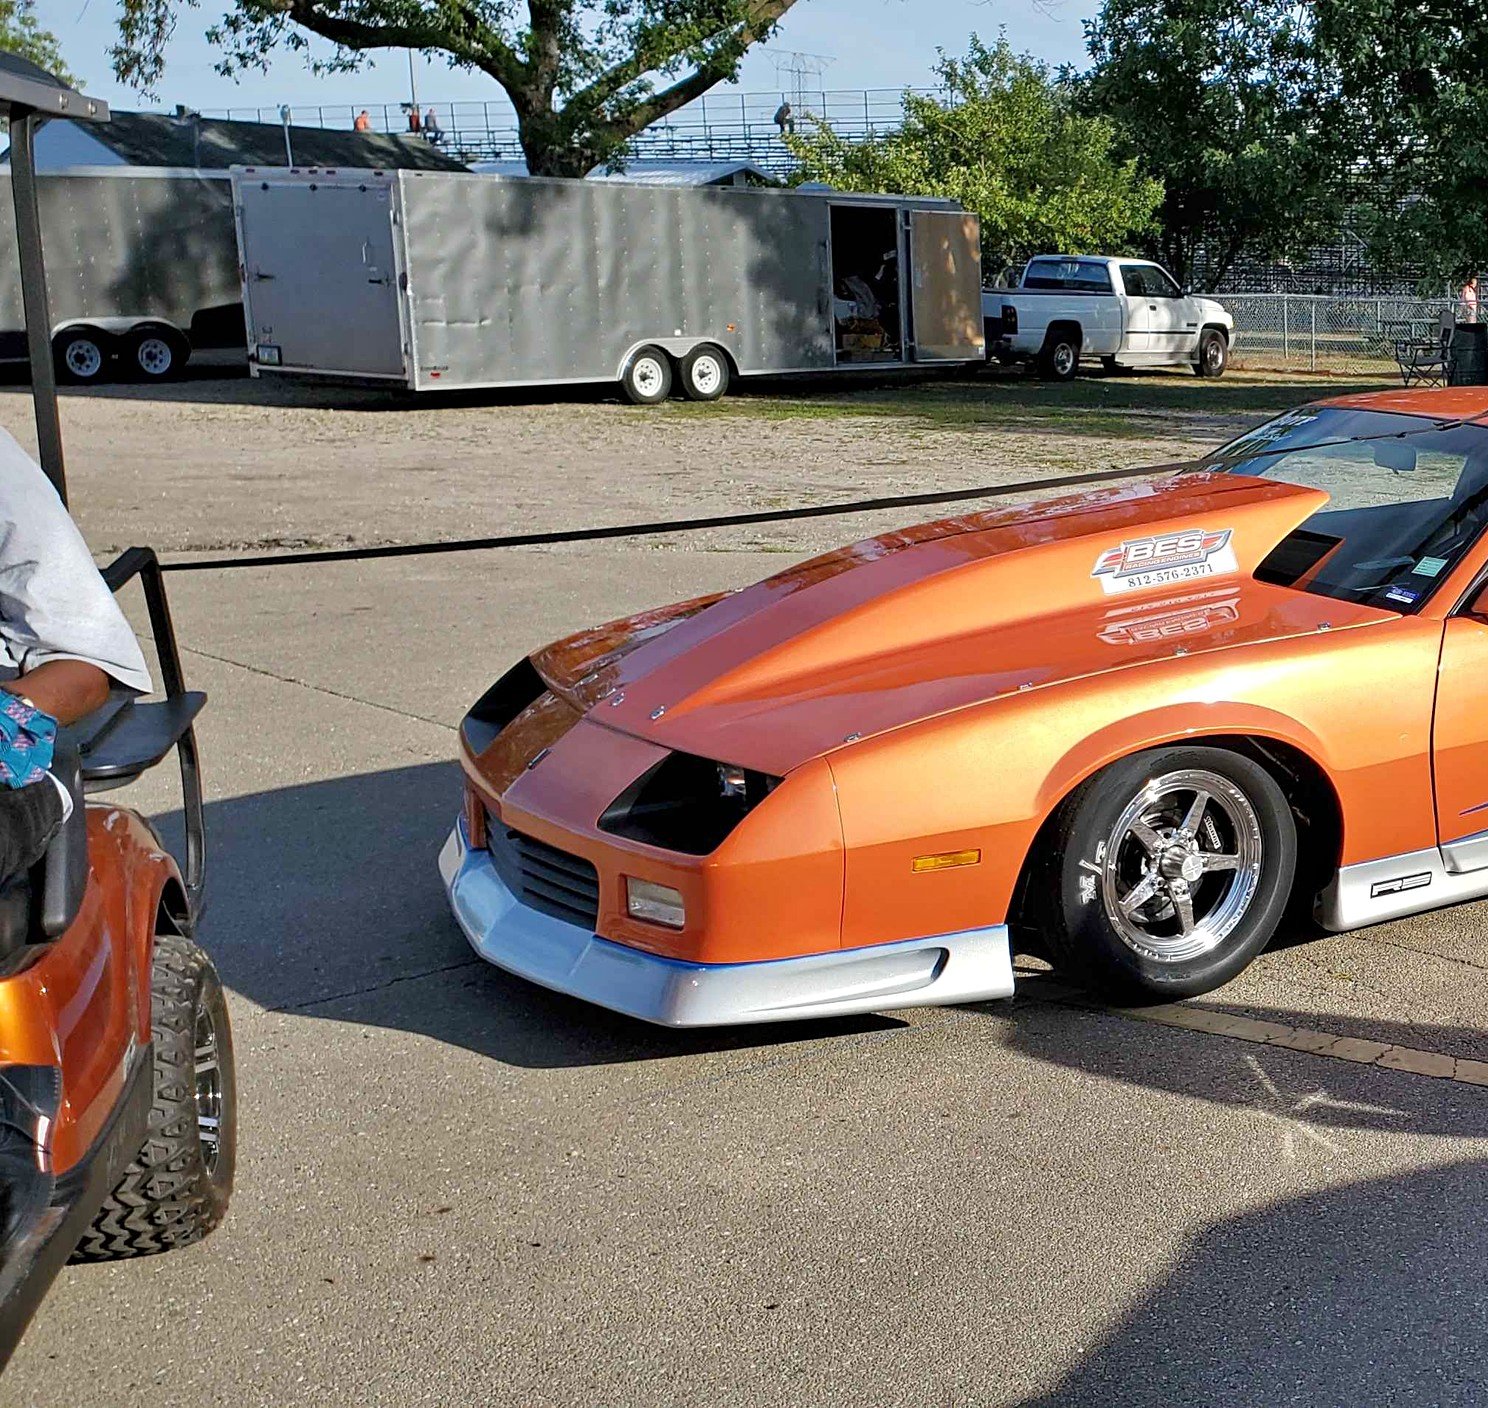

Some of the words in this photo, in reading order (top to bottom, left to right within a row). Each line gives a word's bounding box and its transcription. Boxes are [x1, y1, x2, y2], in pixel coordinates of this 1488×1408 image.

[1127, 533, 1202, 562] BES
[1125, 559, 1160, 570] RACING
[1160, 552, 1200, 563] ENGINES
[1128, 563, 1213, 587] 812-576-2371
[1371, 871, 1432, 898] RS
